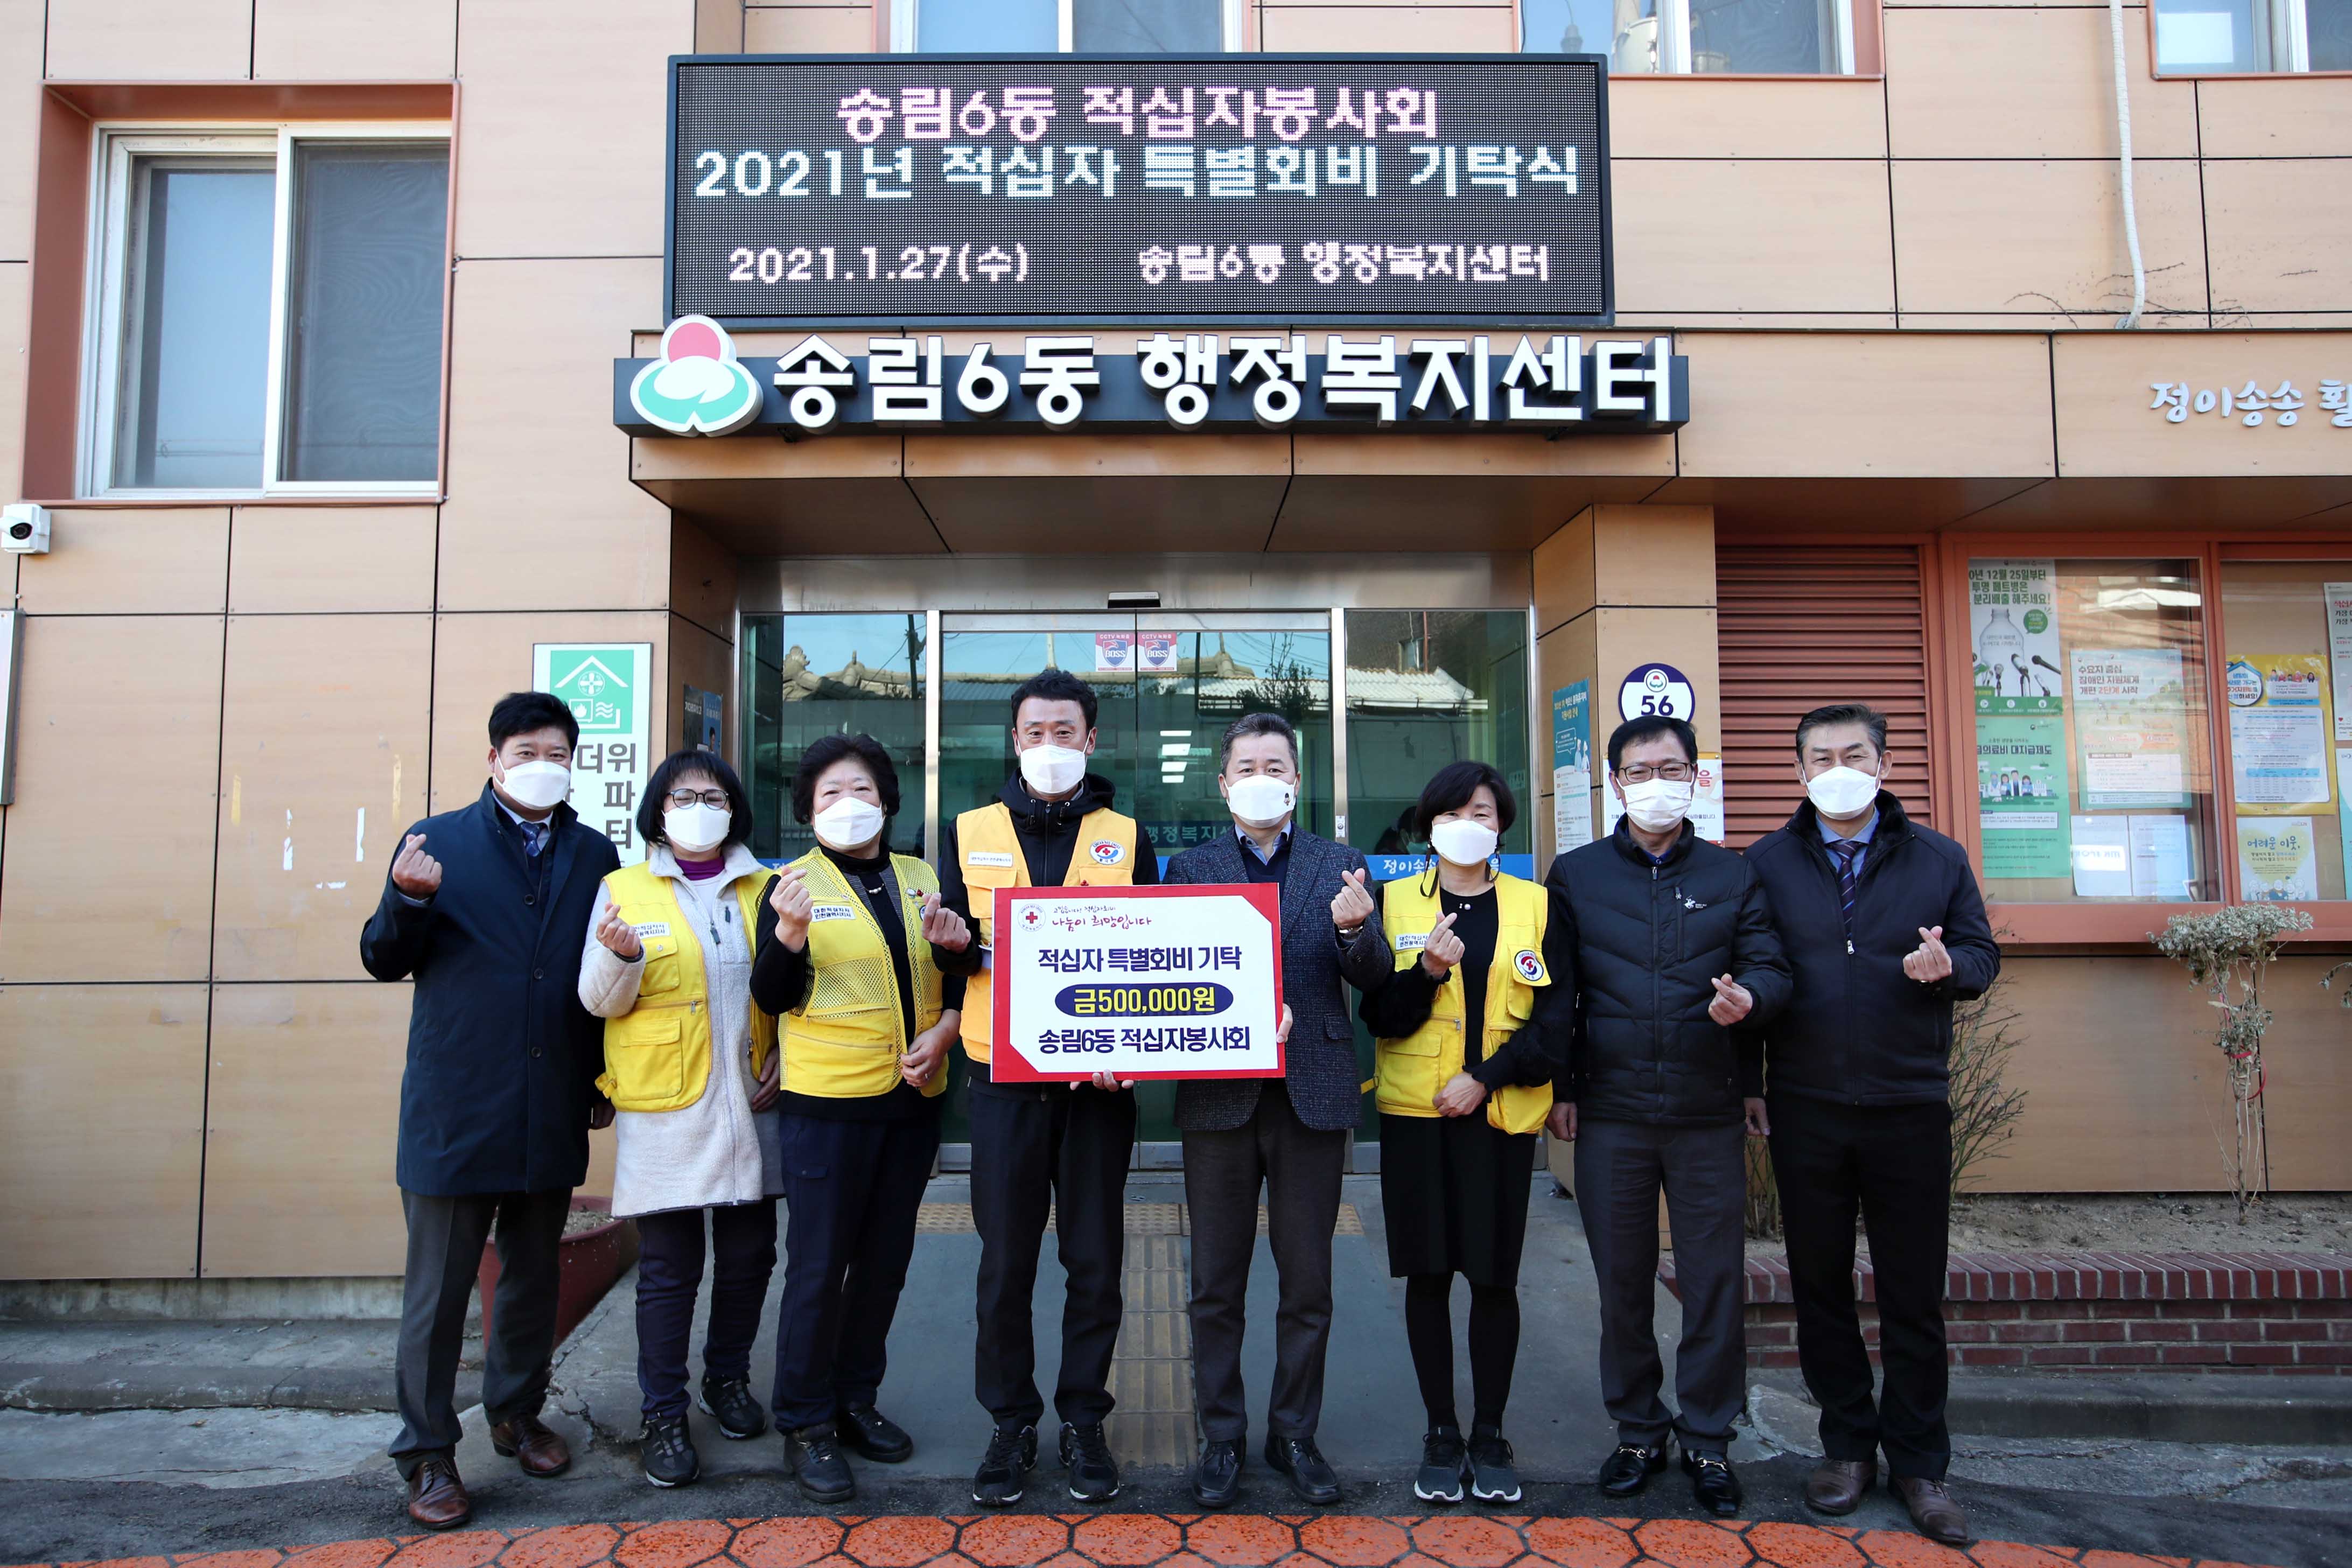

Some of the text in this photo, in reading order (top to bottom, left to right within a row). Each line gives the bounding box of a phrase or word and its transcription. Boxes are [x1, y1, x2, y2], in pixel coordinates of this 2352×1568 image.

[838, 87, 1437, 142] 송림6동 적십자봉사회
[695, 145, 1579, 199] 2021년 적십자 특별회비 기탁식
[729, 242, 1028, 284] 2021.1.27(수)
[1302, 242, 1549, 284] 행정복지센터
[773, 333, 1671, 429] 송림6동 행정복지센터
[2150, 380, 2305, 427] 정이송송
[1972, 581, 1990, 592] 투명
[1987, 569, 2007, 580] 12월
[2010, 569, 2046, 580] 25일부터
[1974, 593, 2050, 605] 분리배출 해주세요!
[1105, 649, 1125, 657] BOSS
[1147, 649, 1168, 657] BOSS
[1640, 695, 1674, 716] 56
[577, 743, 636, 774] 더위
[1697, 769, 1712, 787] 을
[2248, 836, 2276, 850] 어려운
[1052, 914, 1152, 932] 나눔이 희망입니다
[1038, 946, 1242, 973] 적십자 특별회비 기탁
[1073, 986, 1216, 1014] 금500,000원
[1038, 1026, 1251, 1054] 송림6동 적십자봉사회
